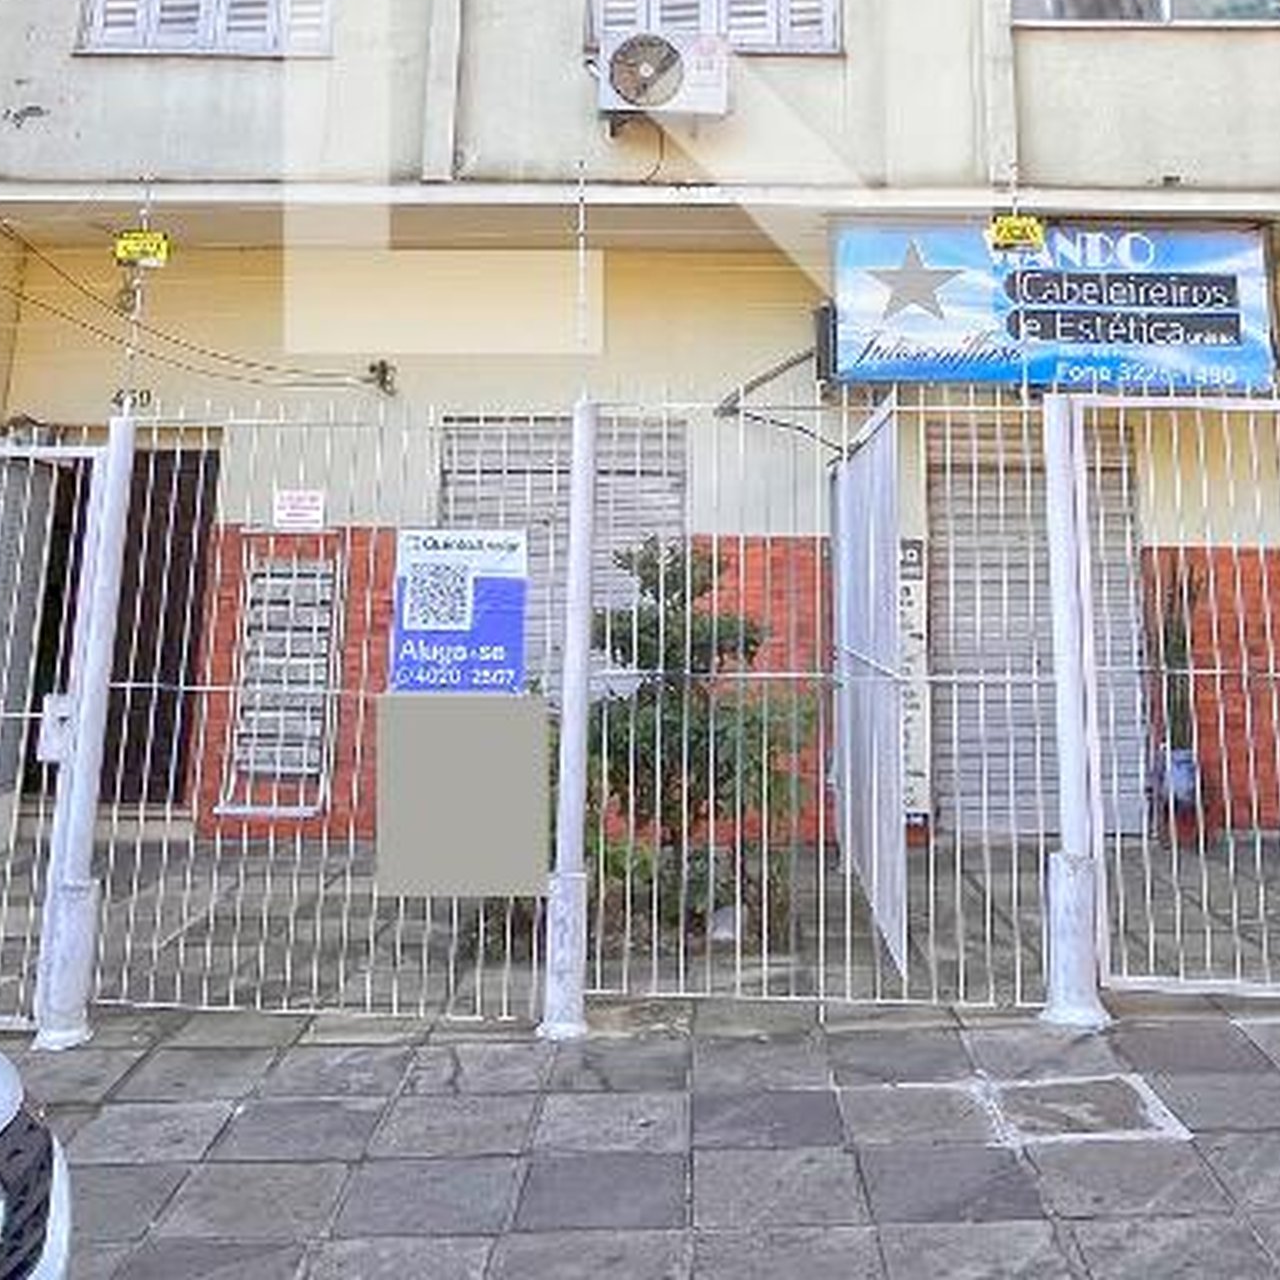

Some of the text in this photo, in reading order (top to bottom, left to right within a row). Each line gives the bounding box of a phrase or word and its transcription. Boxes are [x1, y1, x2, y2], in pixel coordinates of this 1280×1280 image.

[1022, 273, 1227, 308] Cabeleireiros
[1024, 319, 1042, 342] e
[1056, 312, 1184, 345] Estética
